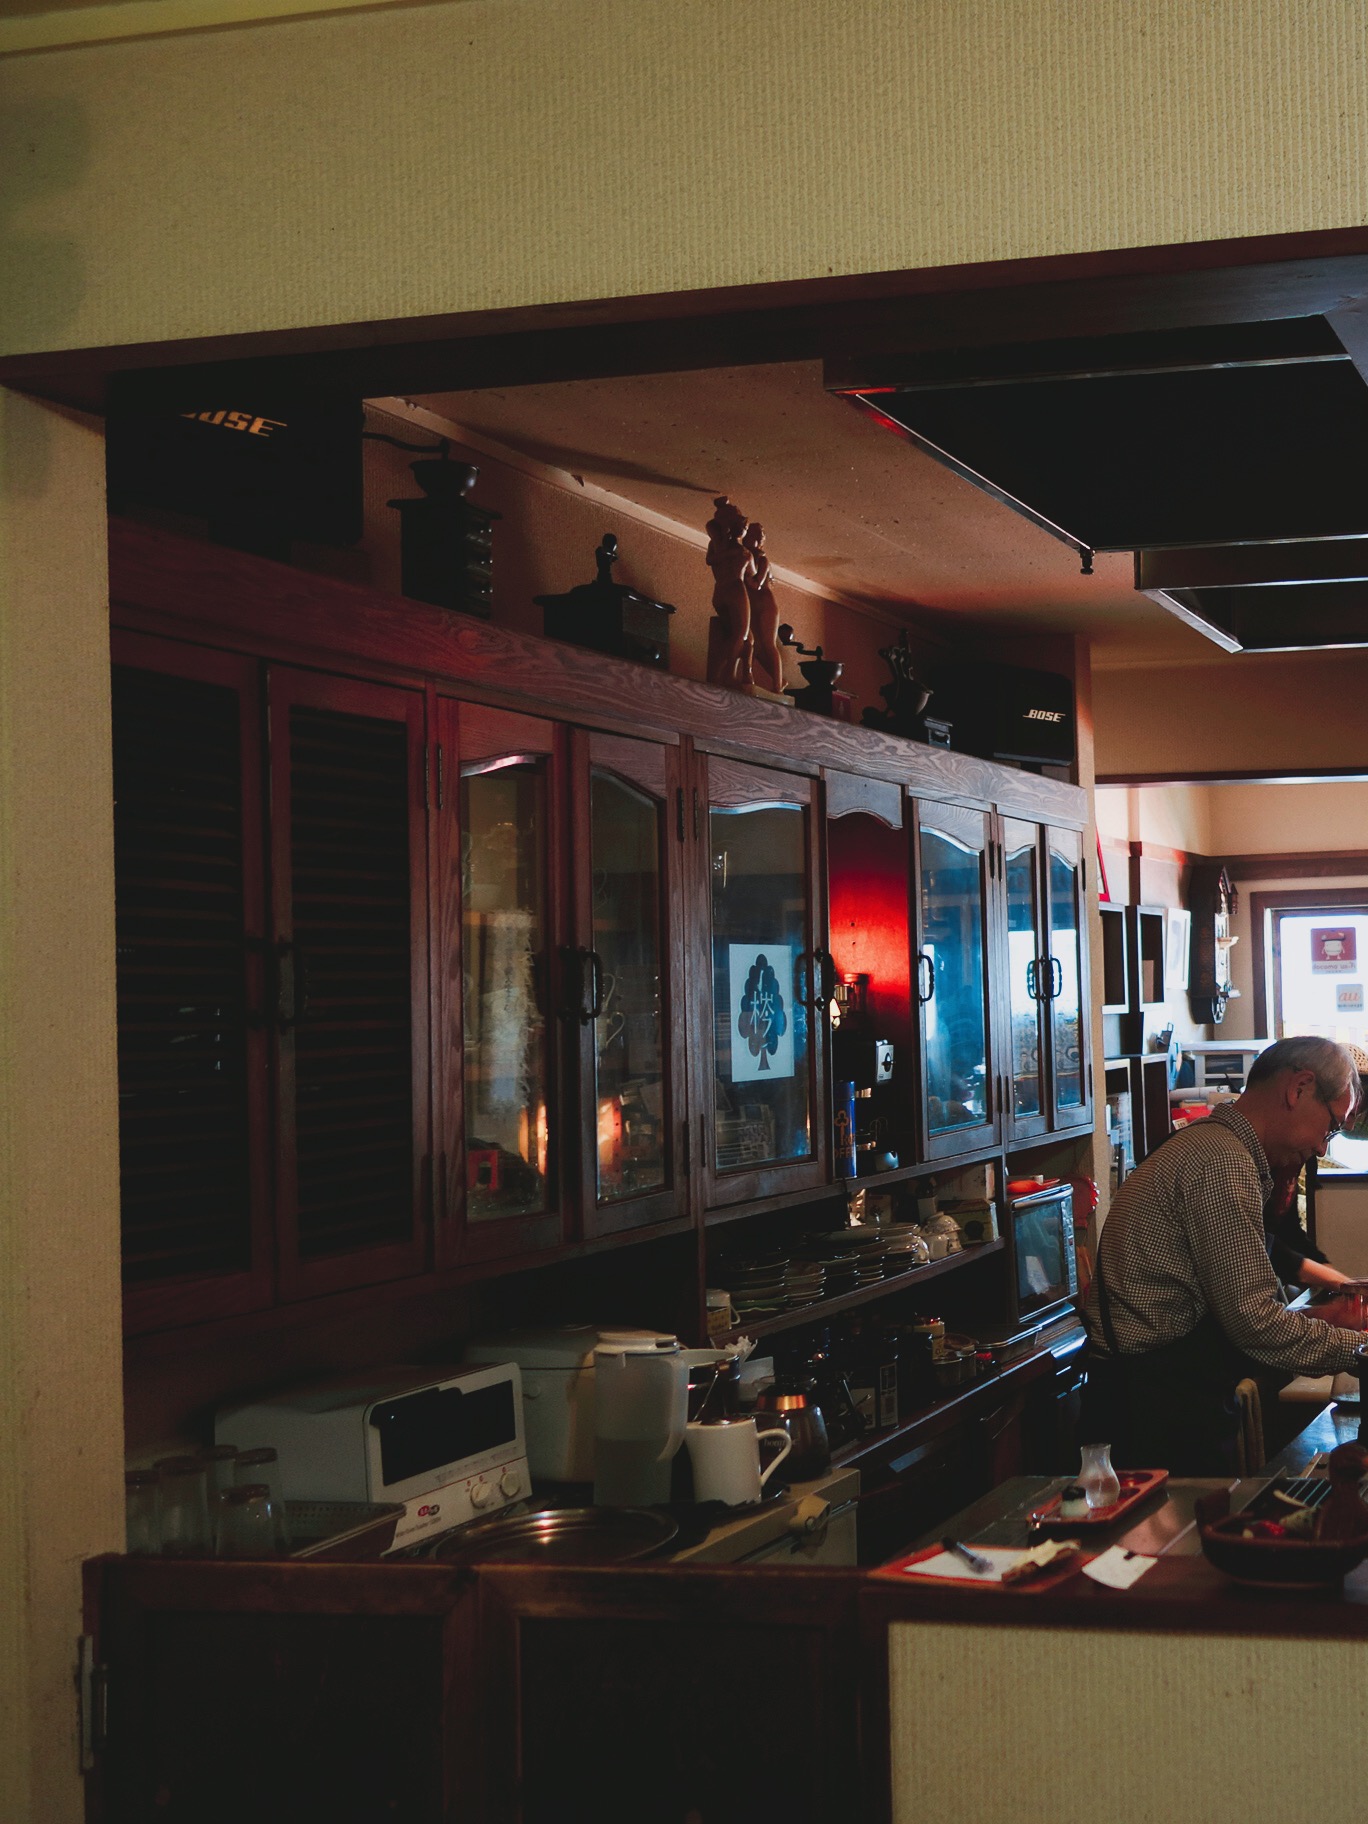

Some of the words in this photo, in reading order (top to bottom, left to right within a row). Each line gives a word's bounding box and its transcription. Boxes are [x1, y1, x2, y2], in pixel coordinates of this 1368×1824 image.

[180, 410, 288, 437] OSE
[1022, 709, 1067, 723] BOSE
[1339, 992, 1361, 1002] au
